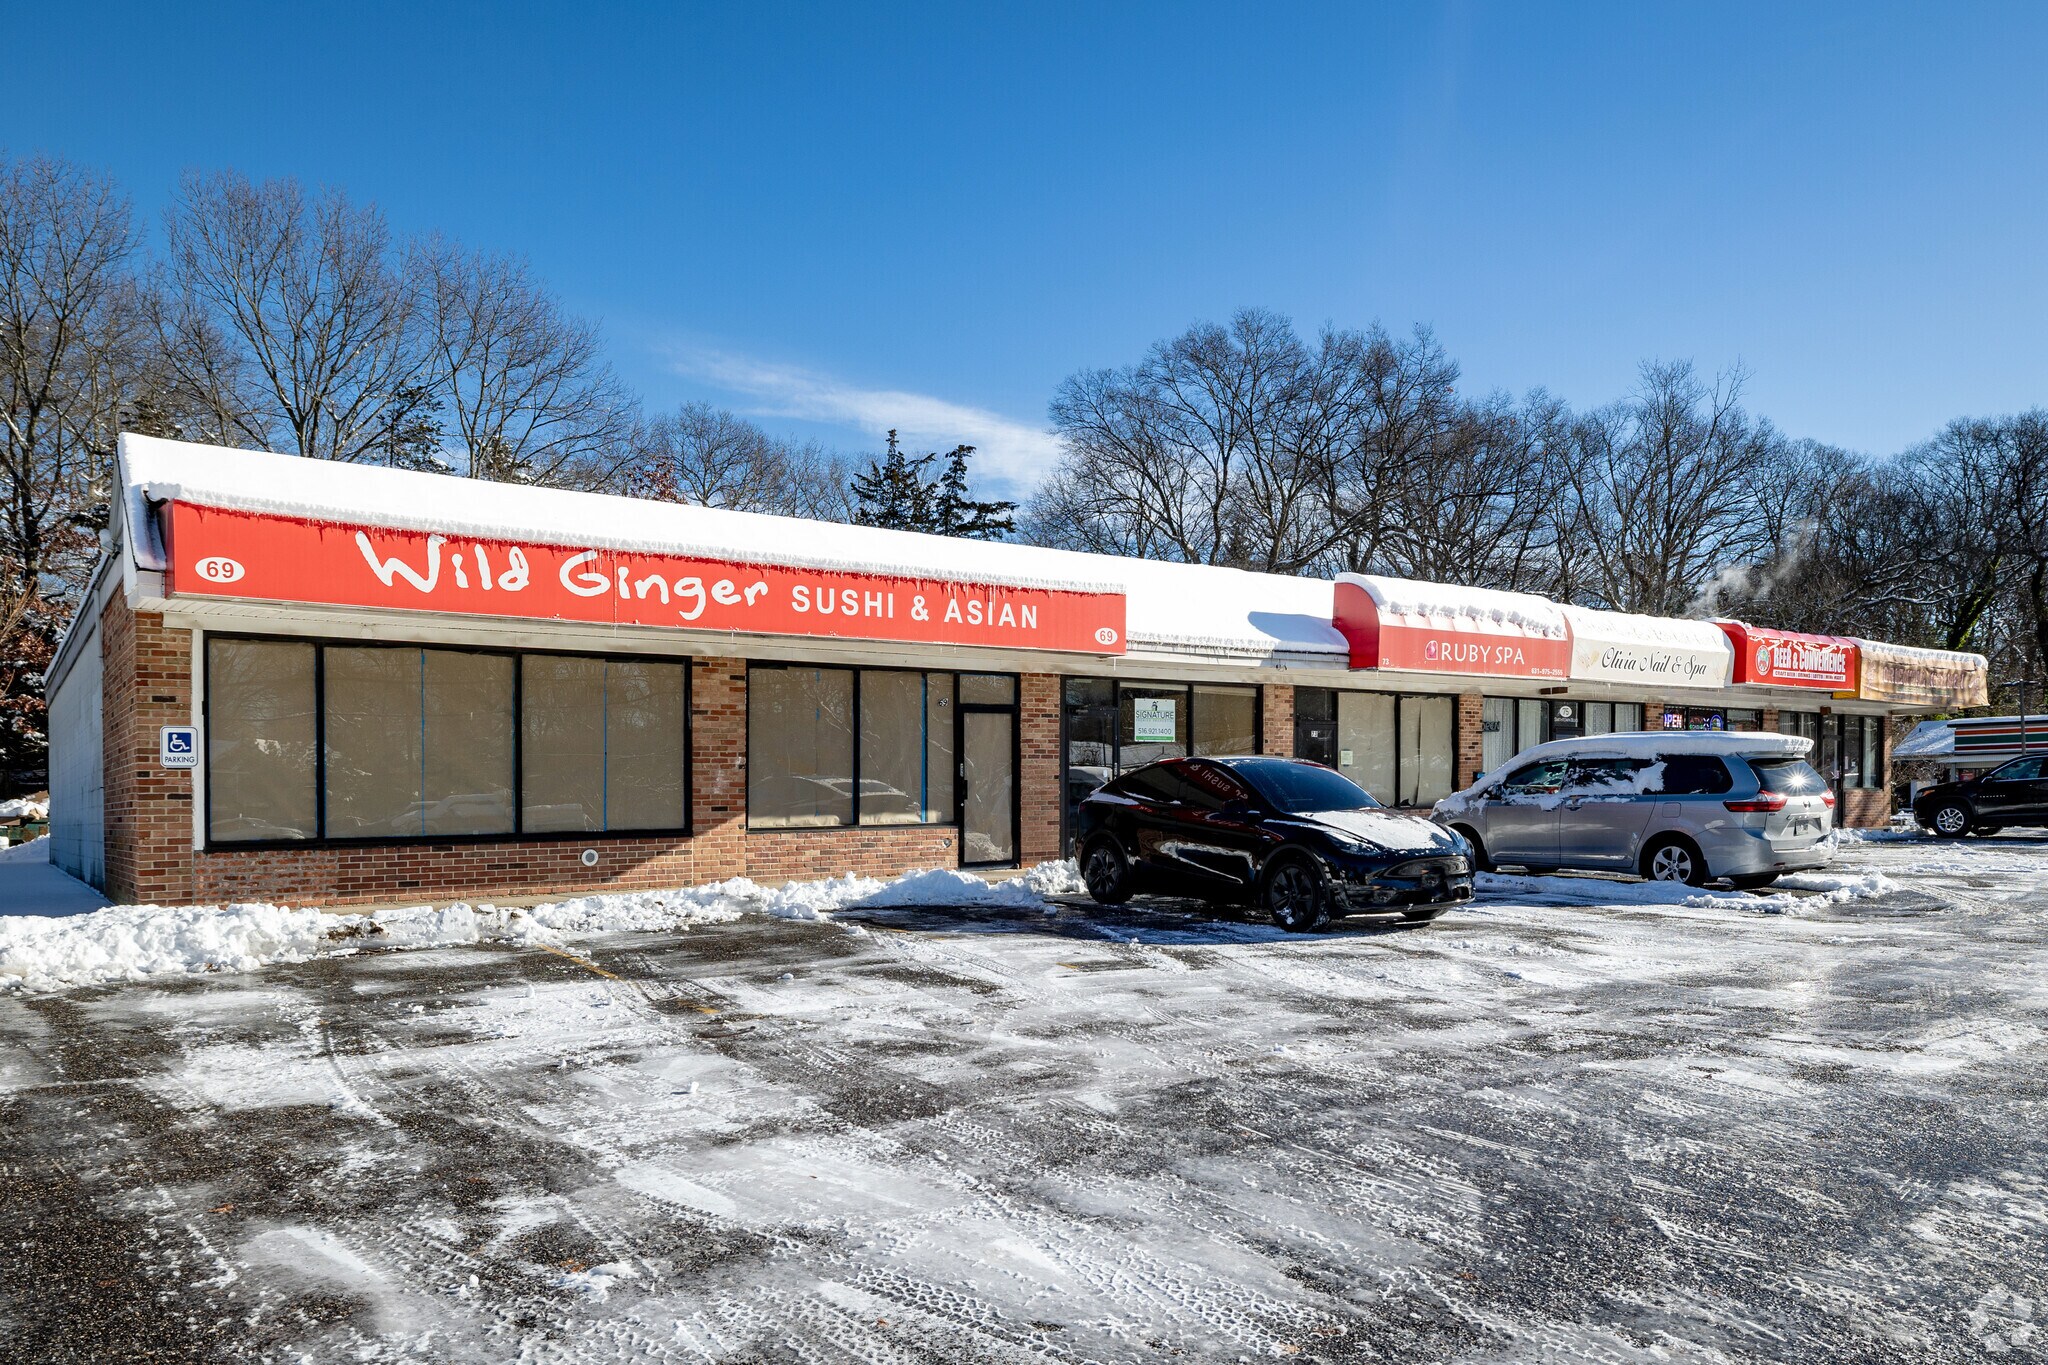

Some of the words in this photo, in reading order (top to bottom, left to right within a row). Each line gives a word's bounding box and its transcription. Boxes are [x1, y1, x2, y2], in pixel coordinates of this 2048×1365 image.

[206, 561, 234, 578] 69
[355, 531, 529, 593] Wild
[559, 549, 768, 620] Ginger
[791, 585, 893, 618] SUSHI
[911, 595, 929, 622] &
[944, 599, 1037, 629] ASIAN
[1099, 629, 1113, 642] 69
[1441, 643, 1491, 663] RUBY
[1495, 646, 1525, 665] SPA
[1602, 647, 1636, 670] Olivia
[1640, 651, 1671, 673] Nail
[1672, 655, 1682, 673] &
[1684, 654, 1707, 680] Spa
[1773, 647, 1792, 669] BEER
[1792, 652, 1798, 669] &
[1136, 711, 1174, 719] SIGNATURE
